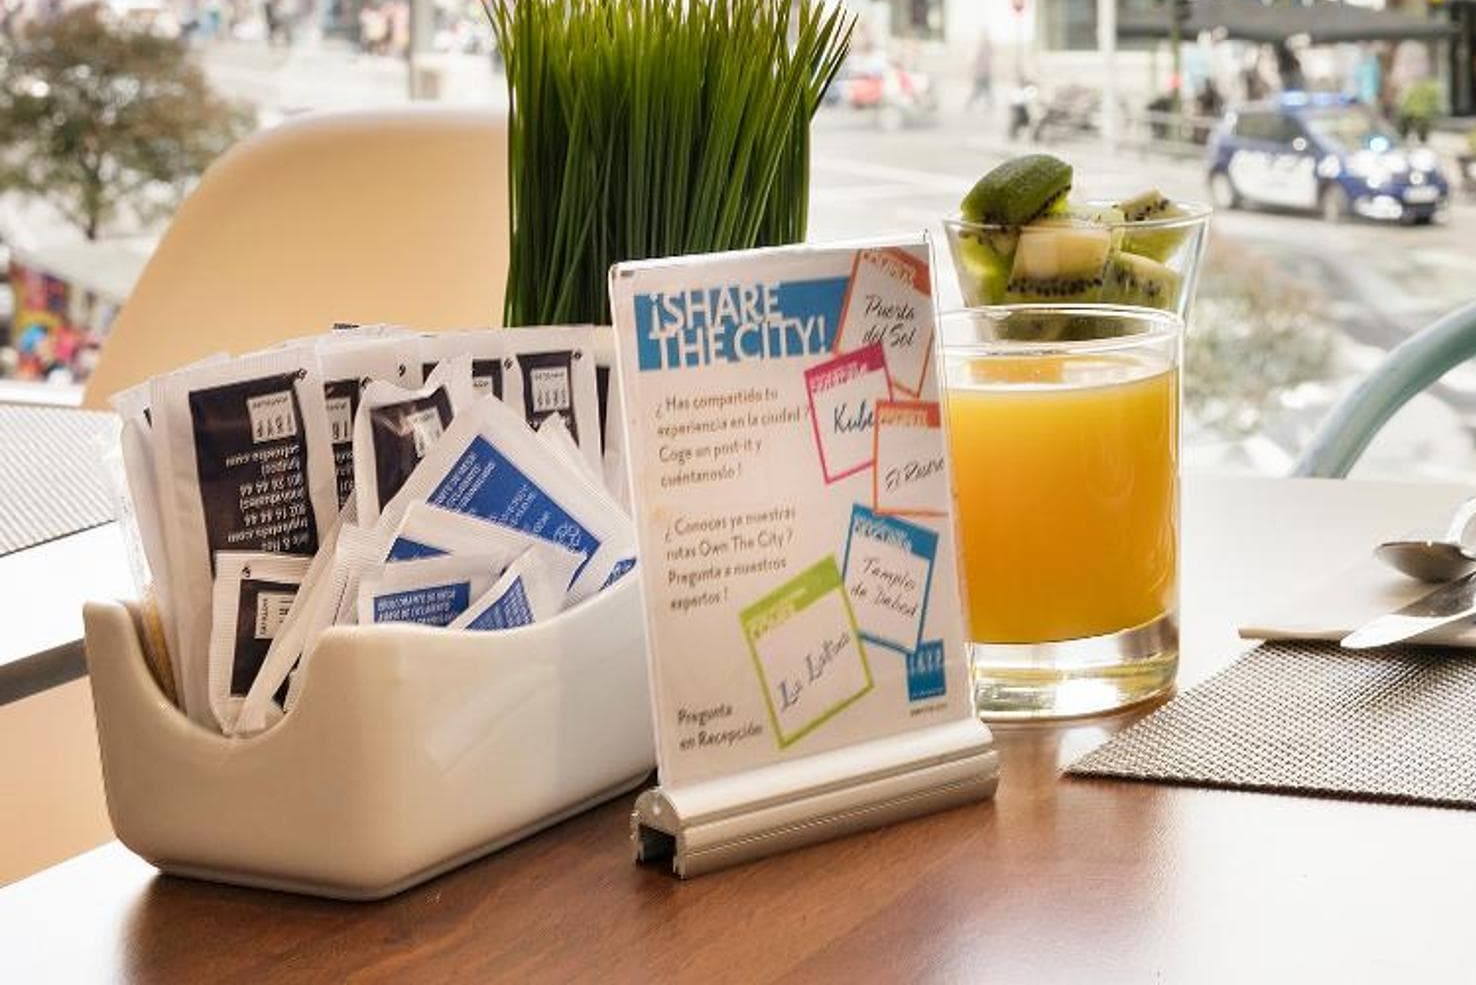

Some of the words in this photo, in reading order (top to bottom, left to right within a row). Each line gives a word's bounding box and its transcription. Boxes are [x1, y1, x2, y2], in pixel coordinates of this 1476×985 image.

[650, 280, 783, 332] ¡SHARE
[649, 324, 728, 367] THE
[734, 316, 827, 362] CITY!
[889, 322, 917, 348] Sol
[693, 386, 763, 411] compartido
[658, 444, 692, 466] Coge
[667, 546, 697, 561] rutas
[699, 537, 729, 557] Own
[730, 534, 755, 552] The
[668, 566, 722, 589] Pregunta
[733, 556, 787, 576] nuestros
[677, 703, 734, 725] Pregunta
[679, 737, 695, 752] en
[698, 719, 764, 750] Recepción
